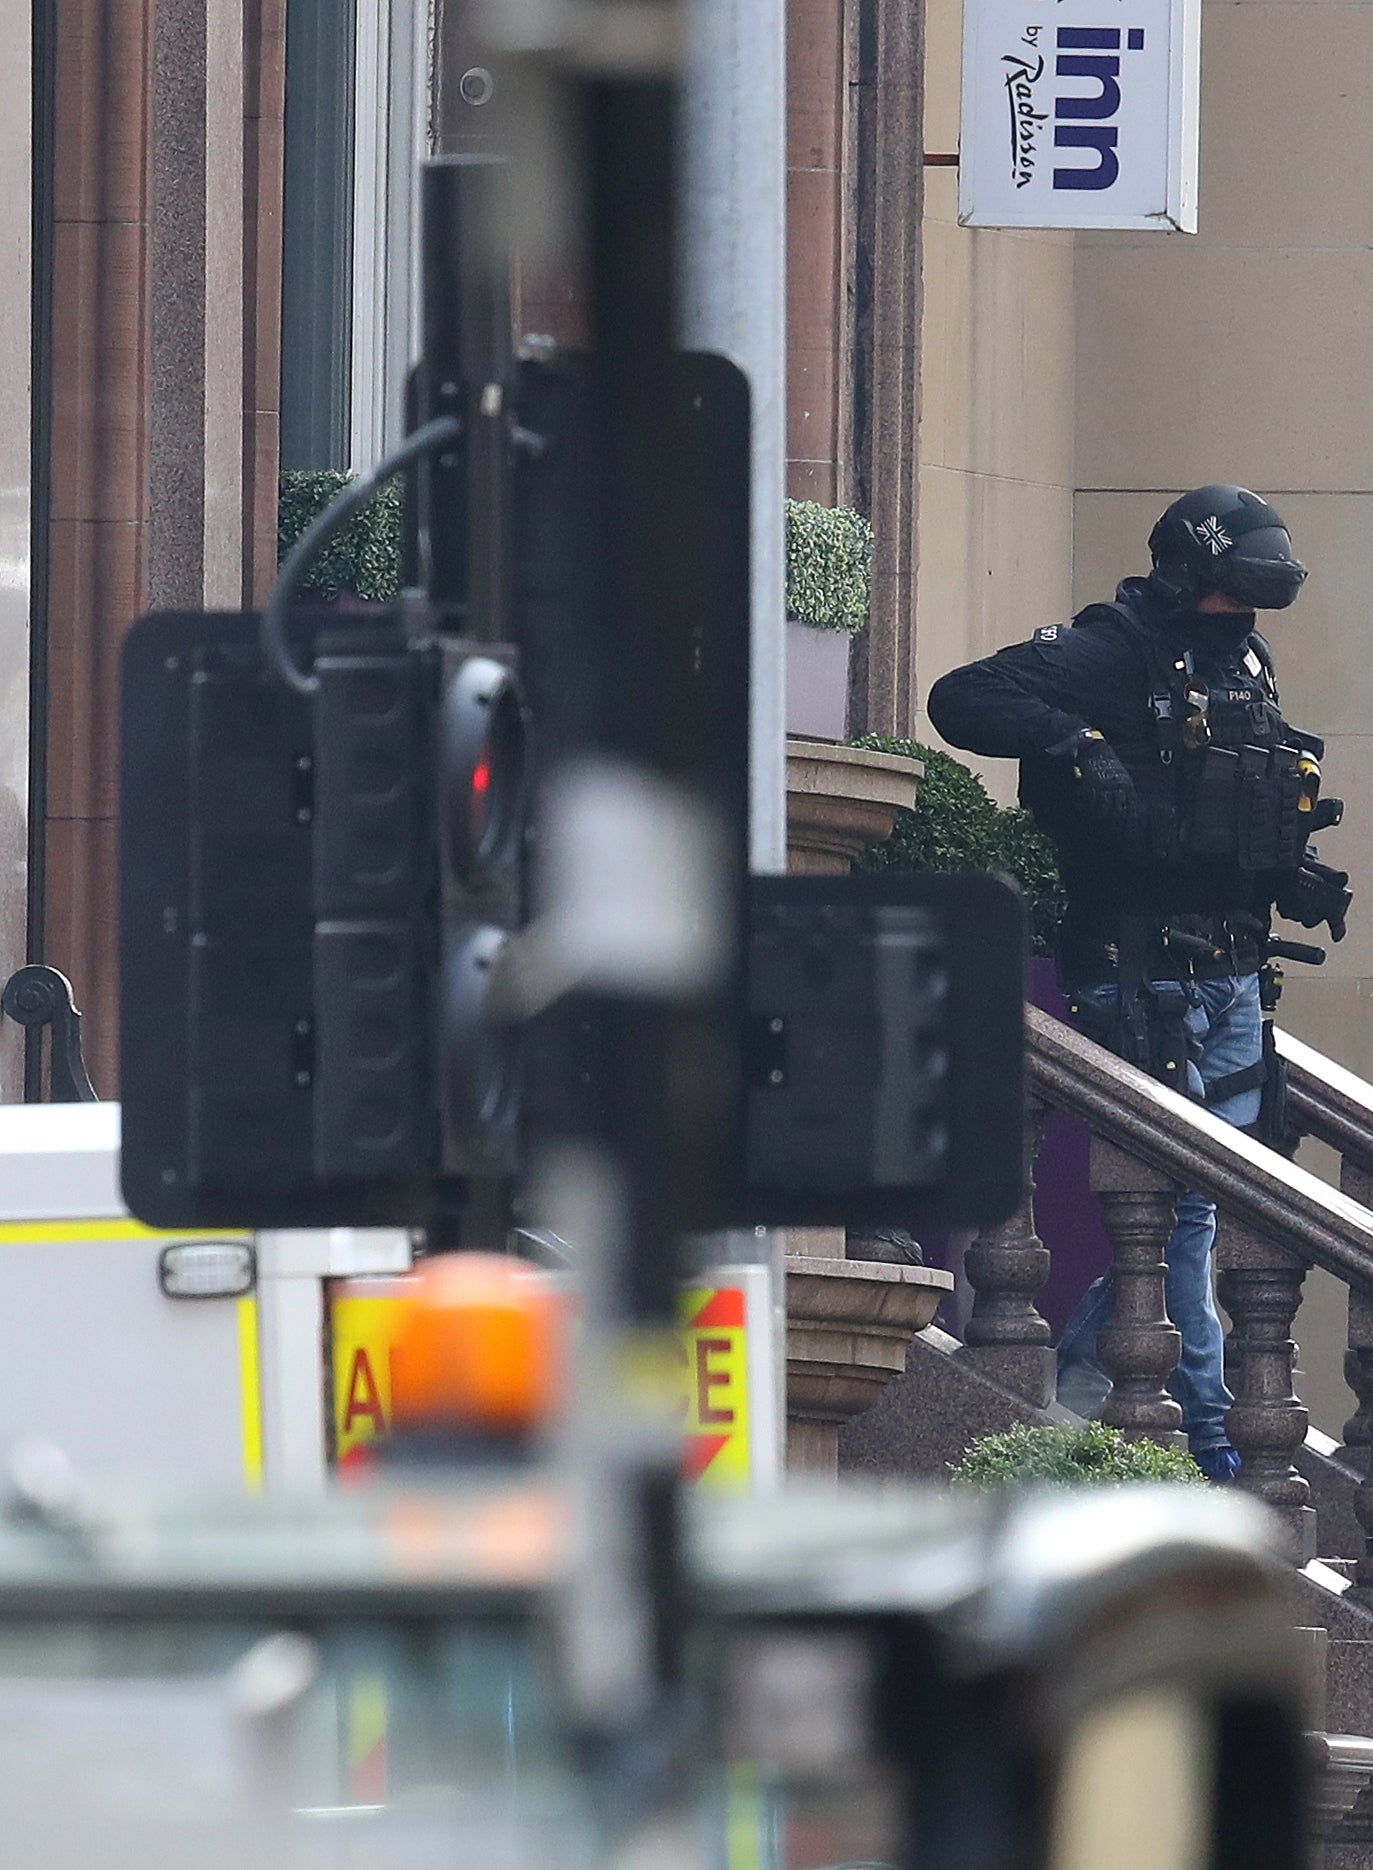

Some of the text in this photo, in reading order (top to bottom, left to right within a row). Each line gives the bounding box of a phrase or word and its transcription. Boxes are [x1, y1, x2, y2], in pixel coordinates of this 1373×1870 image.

[1021, 26, 1043, 48] by
[1001, 54, 1049, 189] Radisson
[1053, 27, 1144, 190] inn
[1229, 690, 1251, 701] F140
